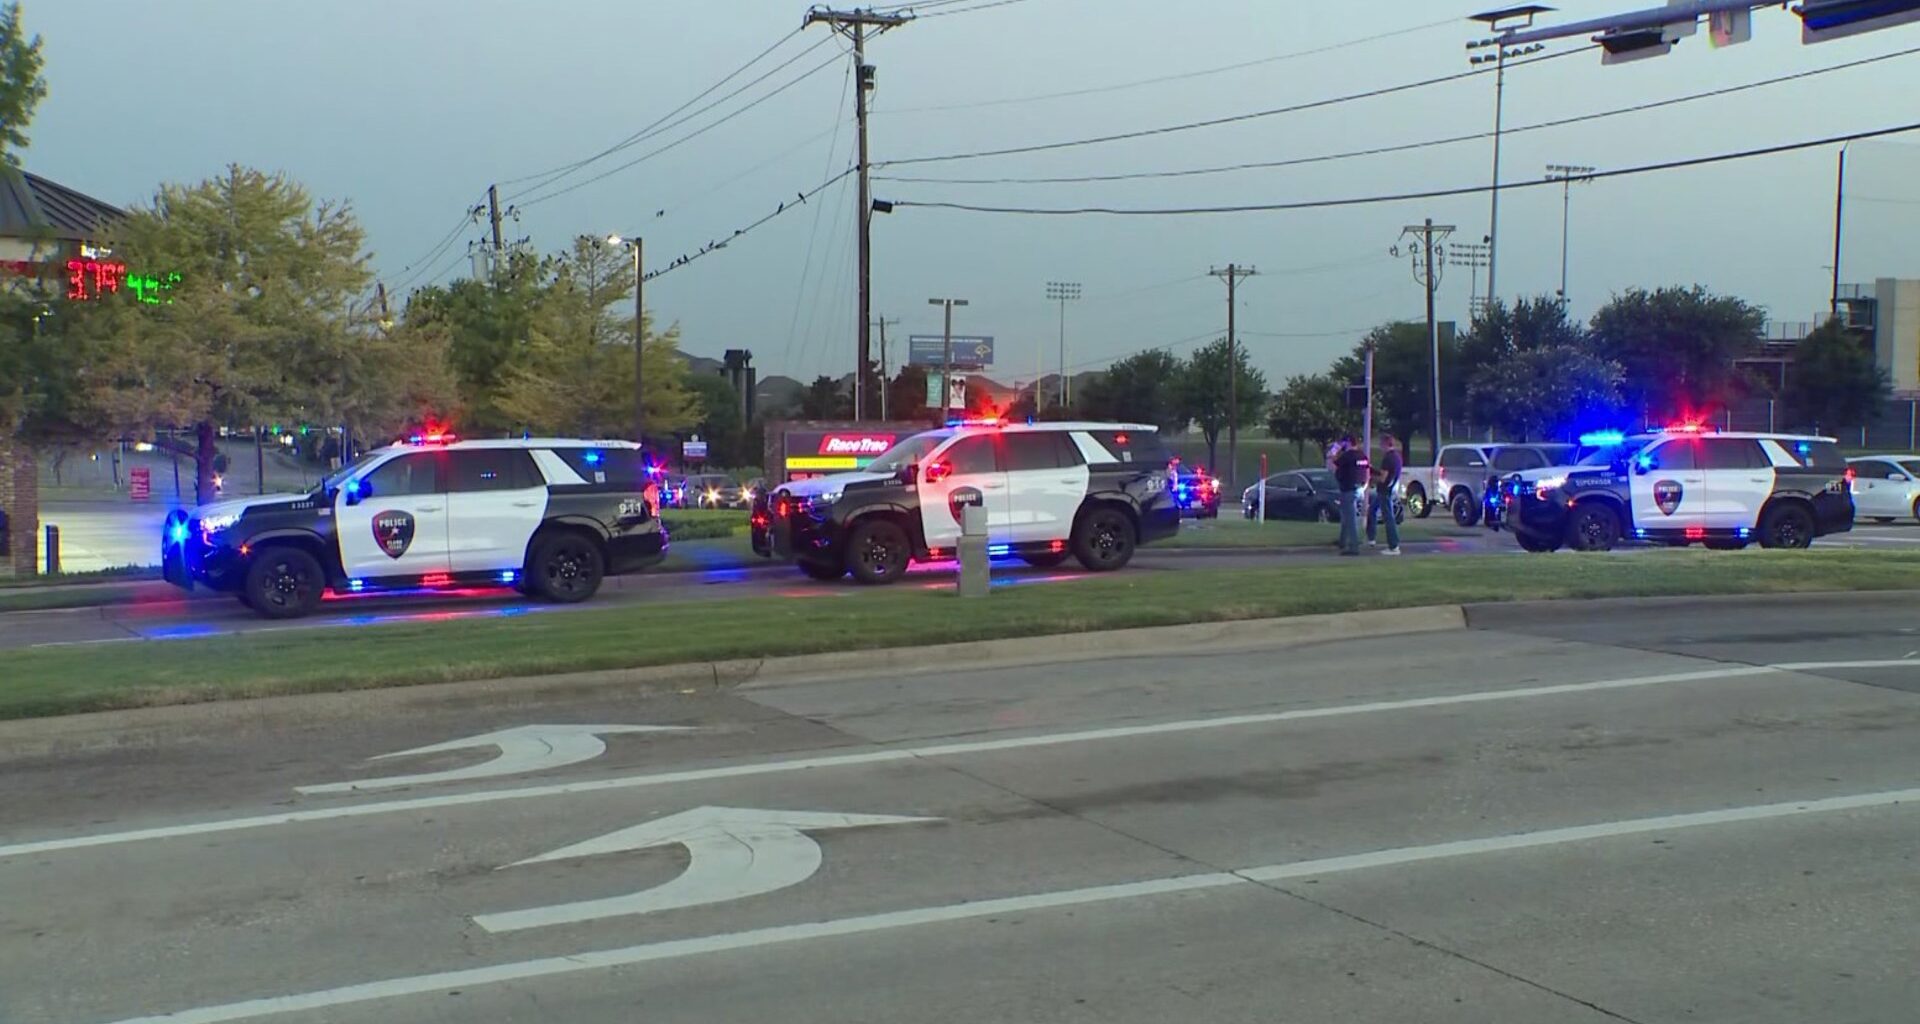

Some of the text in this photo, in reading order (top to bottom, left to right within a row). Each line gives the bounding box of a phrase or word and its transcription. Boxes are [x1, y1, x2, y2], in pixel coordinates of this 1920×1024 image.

[826, 438, 888, 452] RaceTrac
[954, 493, 976, 502] POLICE
[379, 518, 407, 527] POLICE
